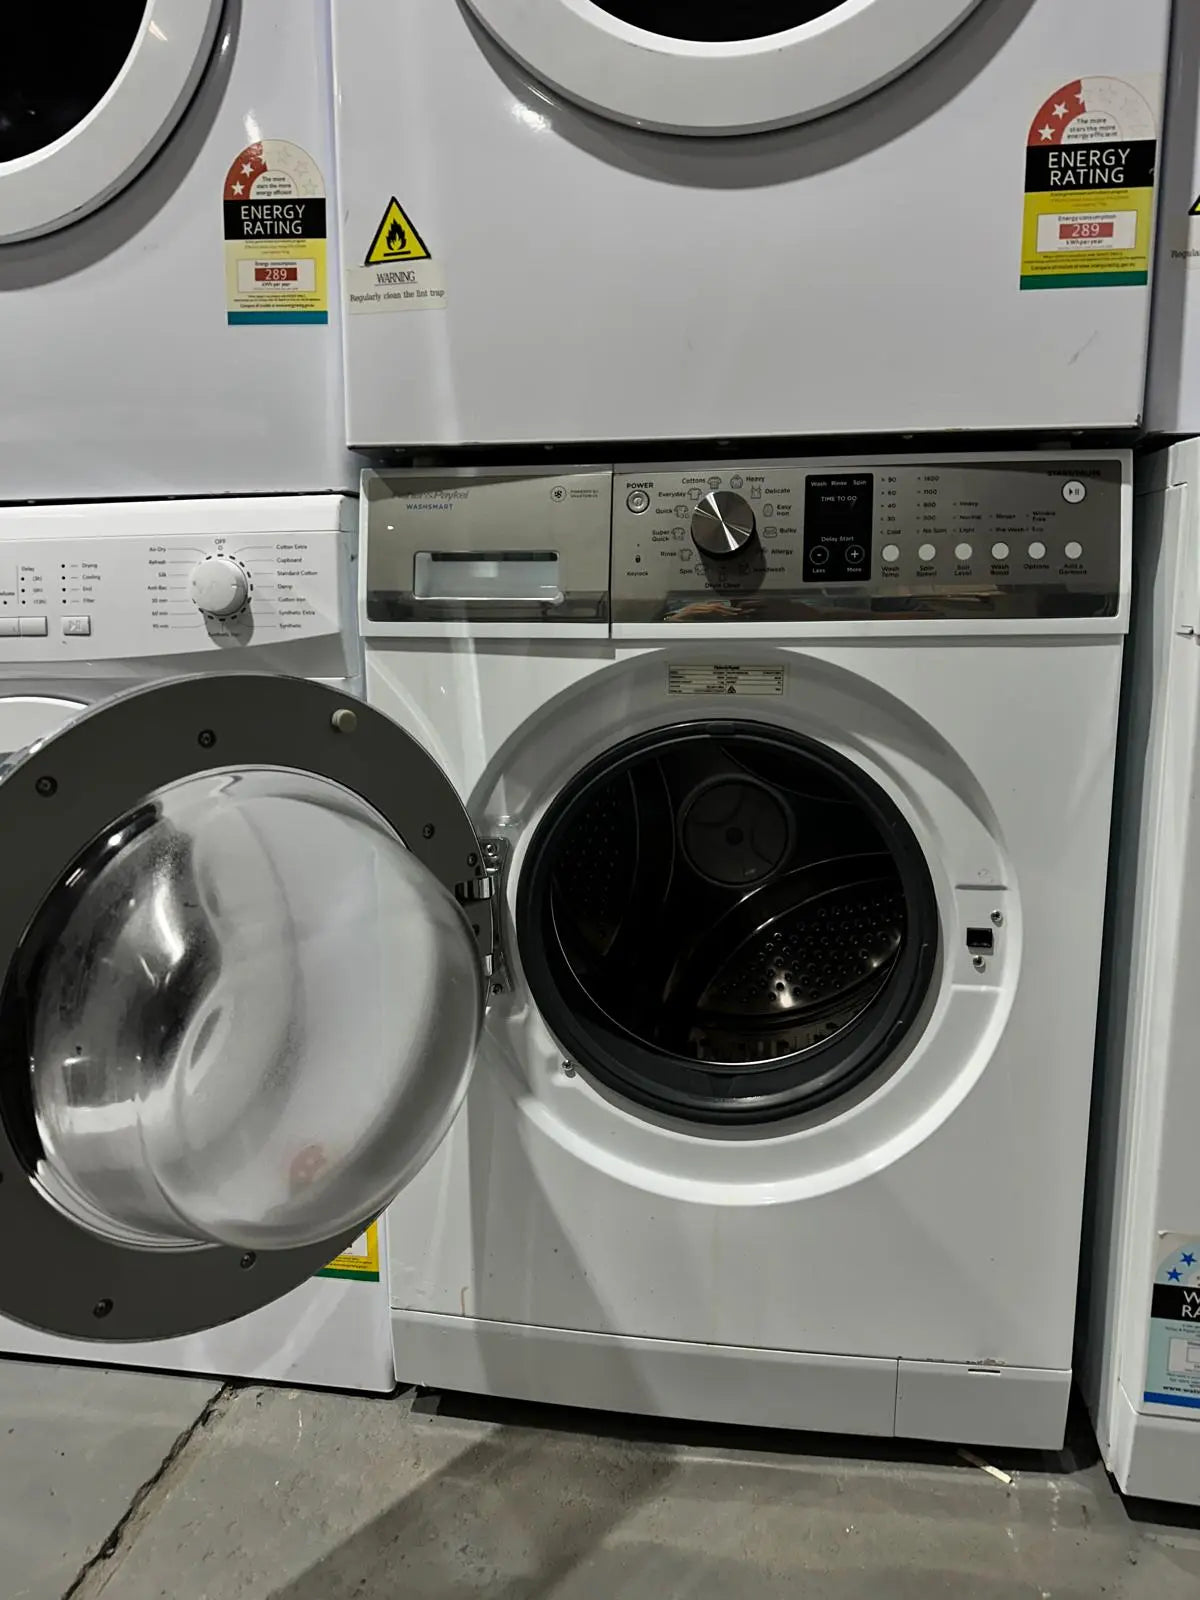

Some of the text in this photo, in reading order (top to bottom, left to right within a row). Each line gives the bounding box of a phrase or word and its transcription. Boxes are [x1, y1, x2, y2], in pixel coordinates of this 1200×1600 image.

[1089, 131, 1118, 139] efficient
[1048, 148, 1131, 169] ENERGY
[1050, 166, 1125, 186] RATING
[240, 204, 306, 220] ENERGY
[243, 220, 303, 235] RATING
[1071, 223, 1100, 237] 289
[265, 268, 288, 281] 289
[376, 270, 416, 283] WARNING
[350, 289, 445, 304] Regularly clean the lint trap
[406, 503, 454, 511] WASHSMART
